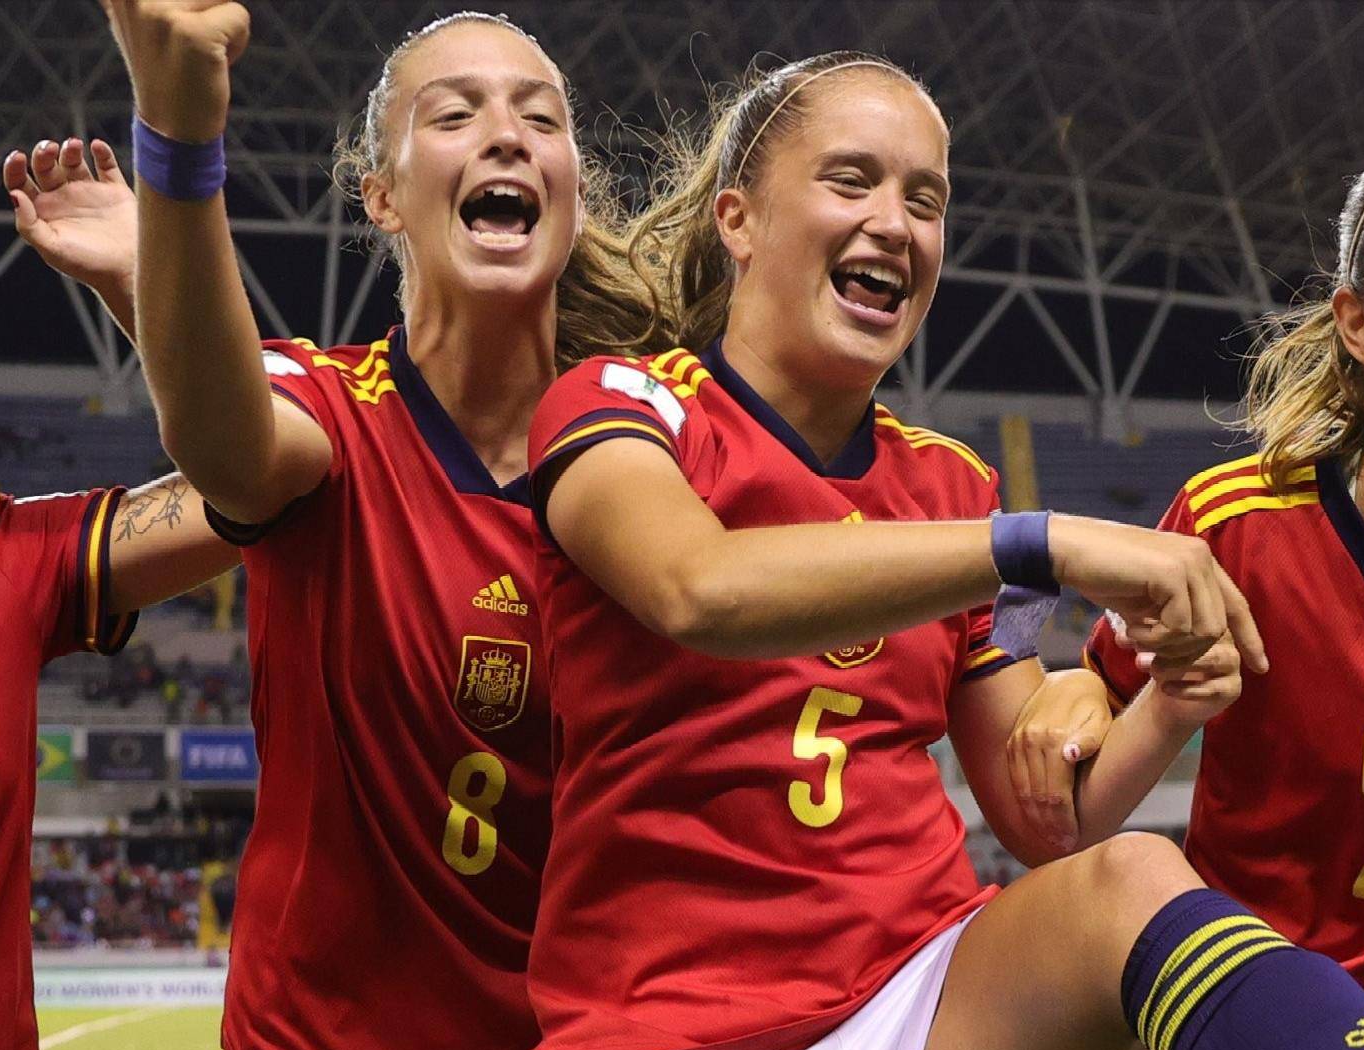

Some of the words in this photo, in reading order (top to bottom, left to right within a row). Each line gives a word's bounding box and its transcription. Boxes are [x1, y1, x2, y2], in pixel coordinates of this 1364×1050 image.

[472, 595, 529, 617] adidas
[441, 751, 507, 876] 8
[788, 686, 863, 828] 5
